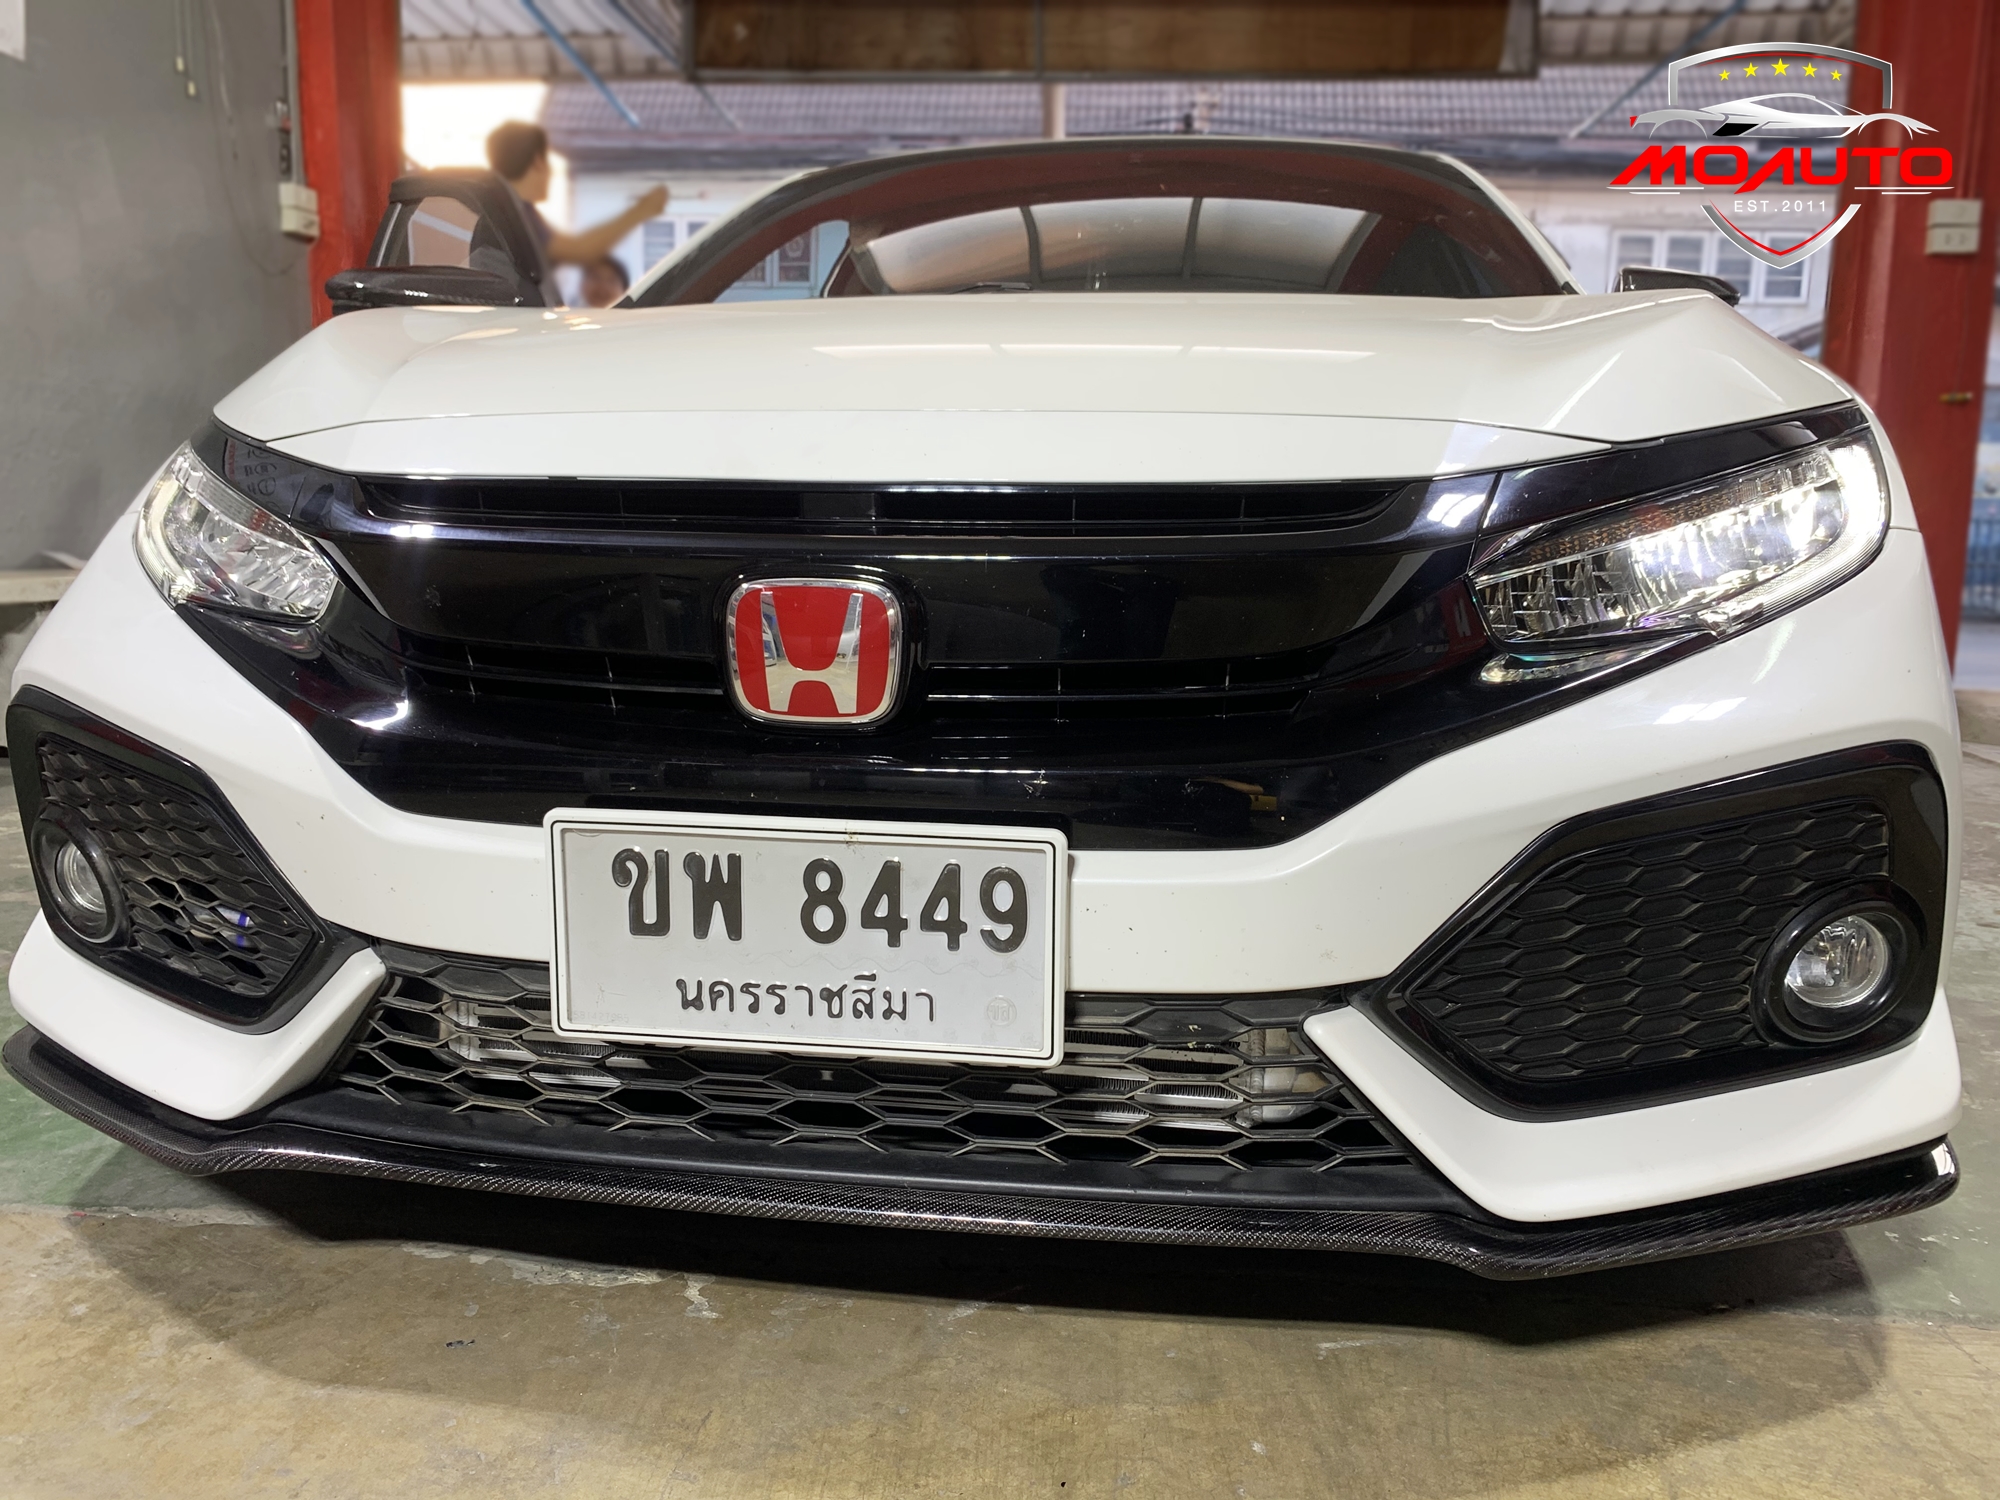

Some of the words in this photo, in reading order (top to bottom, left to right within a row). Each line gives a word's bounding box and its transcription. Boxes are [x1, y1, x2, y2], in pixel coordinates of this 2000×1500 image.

[611, 847, 743, 941] ขพ
[800, 857, 1028, 953] 8449
[675, 973, 936, 1022] นครราชสีมา
